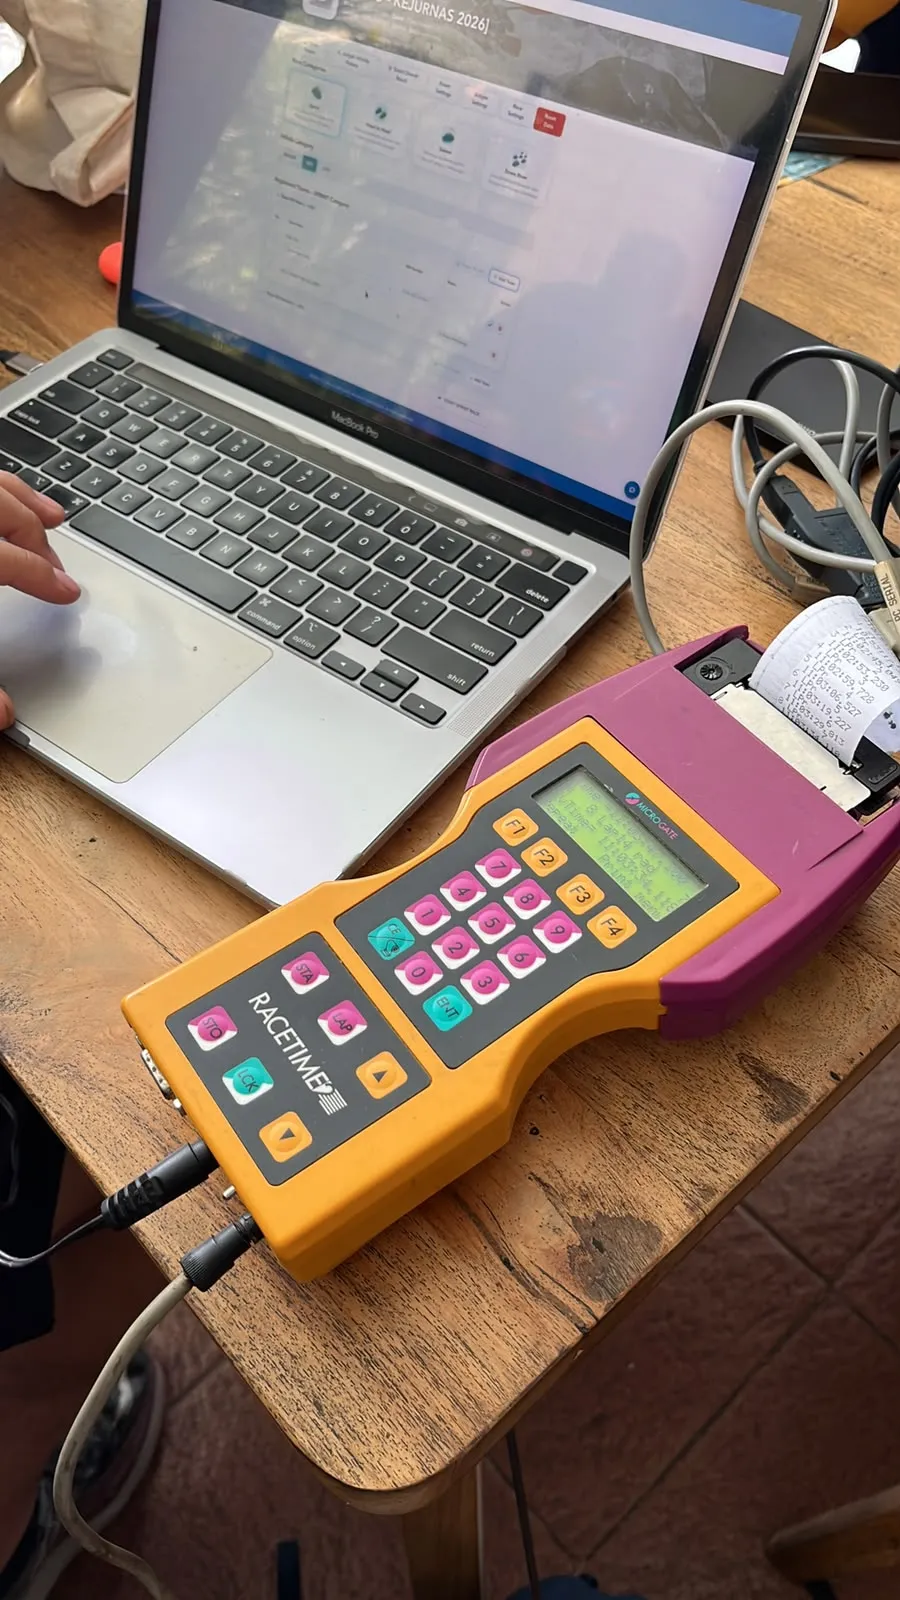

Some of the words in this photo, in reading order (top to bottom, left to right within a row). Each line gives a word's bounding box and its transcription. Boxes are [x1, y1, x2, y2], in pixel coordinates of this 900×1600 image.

[456, 12, 490, 35] 2026]
[127, 423, 142, 433] W
[330, 410, 365, 434] MacBook
[366, 425, 380, 440] Pro
[75, 433, 87, 442] A
[158, 439, 170, 448] E
[105, 447, 118, 457] S
[190, 454, 200, 462] R
[59, 461, 72, 471] Z
[135, 463, 148, 472] D
[262, 460, 273, 468] 6
[223, 470, 233, 478] T
[90, 477, 102, 487] X
[168, 479, 180, 488] F
[256, 485, 266, 495] Y
[121, 493, 133, 503] C
[200, 496, 212, 505] G
[329, 492, 340, 500] 8
[288, 503, 300, 511] U
[155, 509, 166, 519] V
[232, 512, 246, 521] H
[364, 509, 375, 517] 9
[185, 527, 198, 536] B
[268, 531, 280, 539] J
[219, 544, 232, 555] N
[302, 547, 315, 557] K
[394, 555, 406, 564] P
[253, 562, 268, 573] M
[338, 565, 347, 575] L
[880, 572, 898, 607] SERIAL
[525, 587, 550, 604] delete
[245, 609, 282, 631] command
[291, 634, 317, 650] option
[470, 641, 496, 658] return
[446, 672, 467, 687] shift
[635, 801, 679, 840] MICROGATE
[505, 818, 526, 837] F1
[533, 847, 555, 866] F2
[490, 861, 507, 872] 7
[456, 887, 471, 897] 4
[568, 884, 591, 904] F3
[519, 893, 534, 904] 8
[421, 908, 434, 918] 1
[484, 916, 501, 929] 5
[600, 917, 624, 937] F4
[385, 922, 401, 935] CE
[549, 925, 565, 935] 9
[447, 942, 464, 954] 2
[514, 952, 530, 963] 6
[295, 963, 314, 984] STA
[411, 966, 426, 978] 0
[477, 976, 493, 989] 3
[436, 996, 459, 1019] ENT
[202, 1017, 223, 1039] STO
[332, 1012, 353, 1034] LAP
[237, 1069, 260, 1093] LCK
